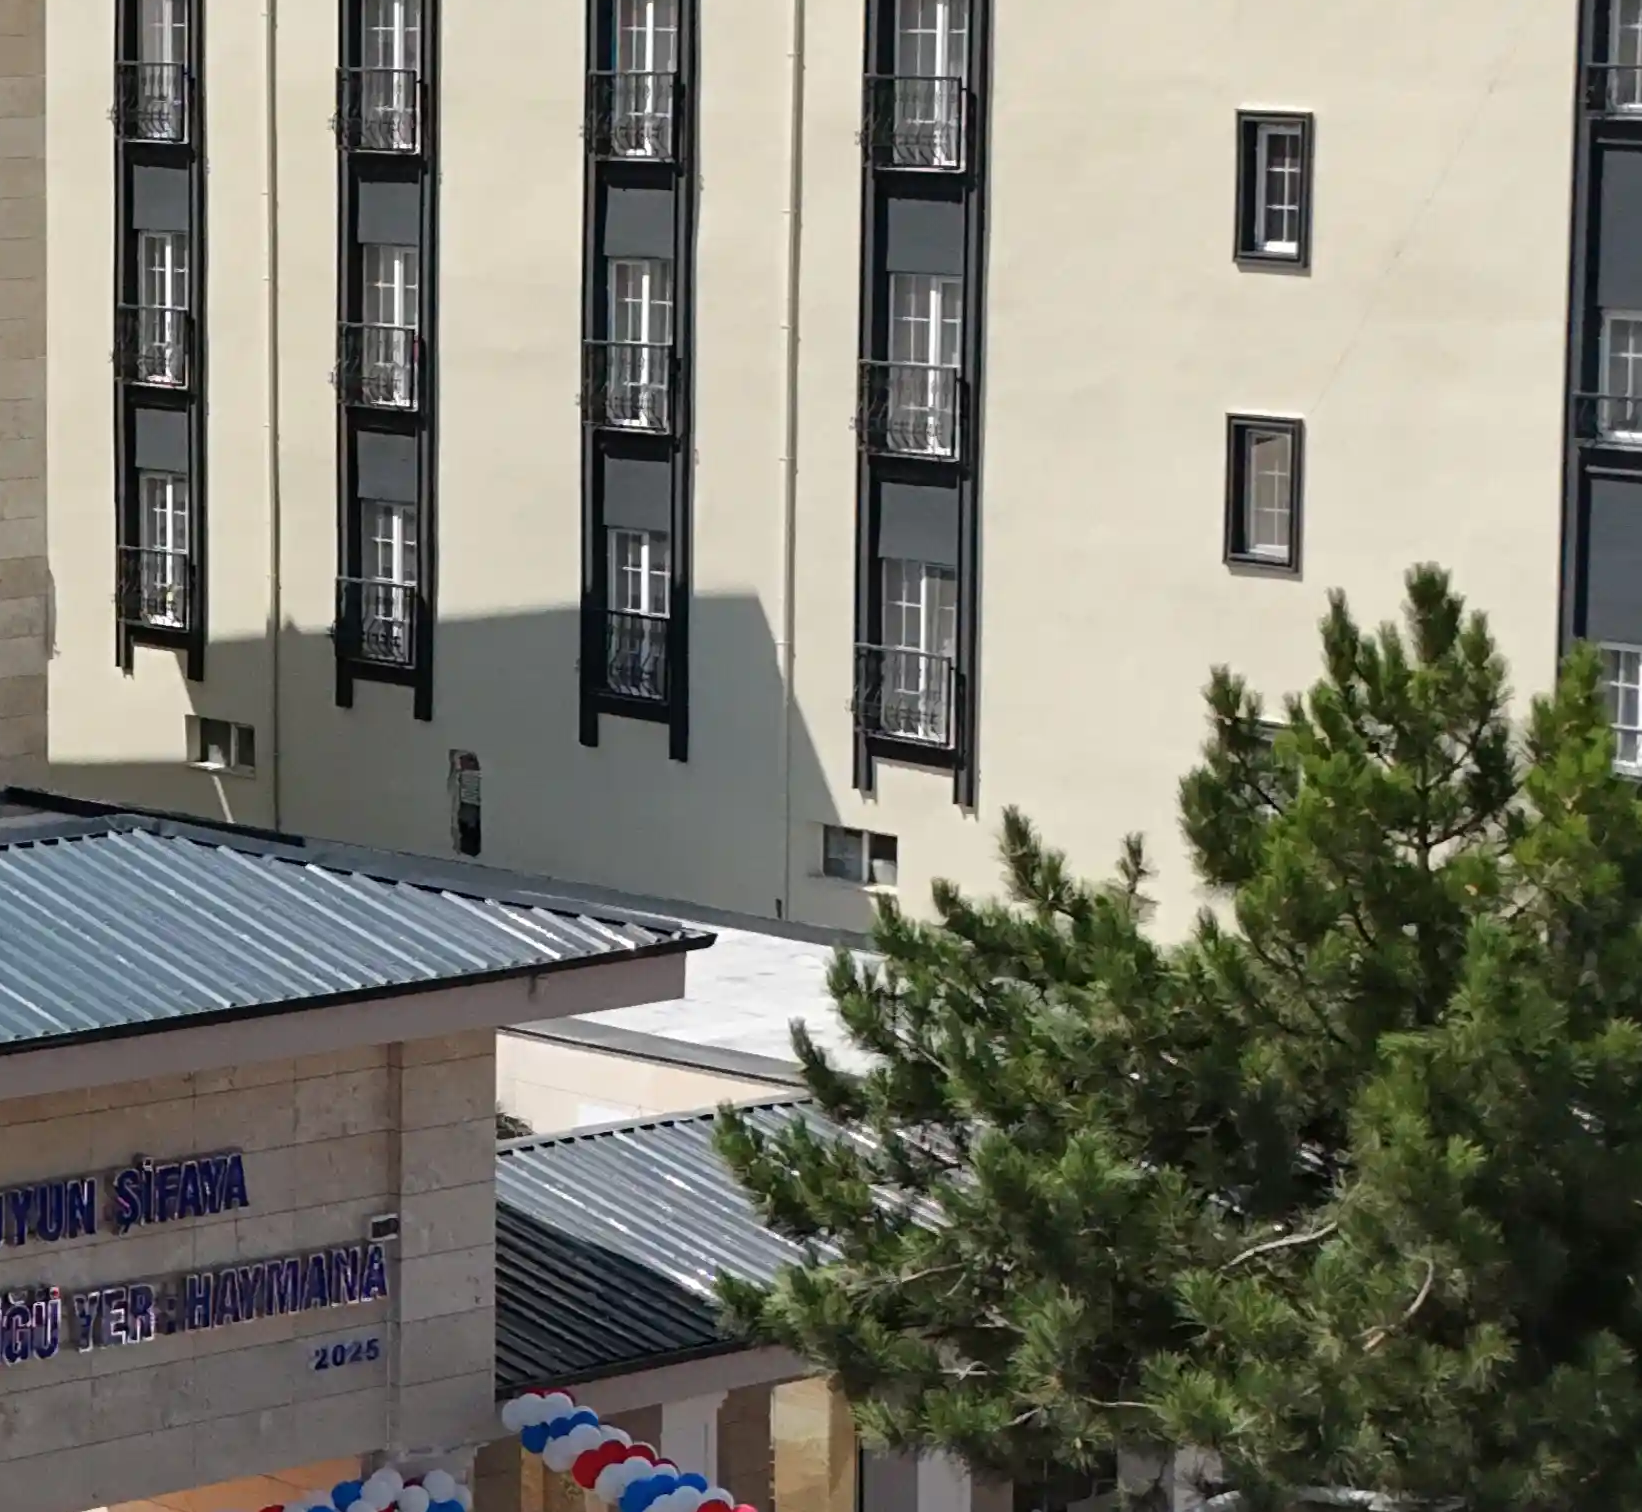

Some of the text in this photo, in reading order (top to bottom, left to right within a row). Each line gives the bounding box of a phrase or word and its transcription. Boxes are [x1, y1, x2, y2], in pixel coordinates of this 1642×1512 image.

[112, 1152, 250, 1238] ŞİFAYA
[73, 1283, 156, 1354] YER
[184, 1241, 389, 1333] HAYMANA
[313, 1338, 381, 1371] 2025
